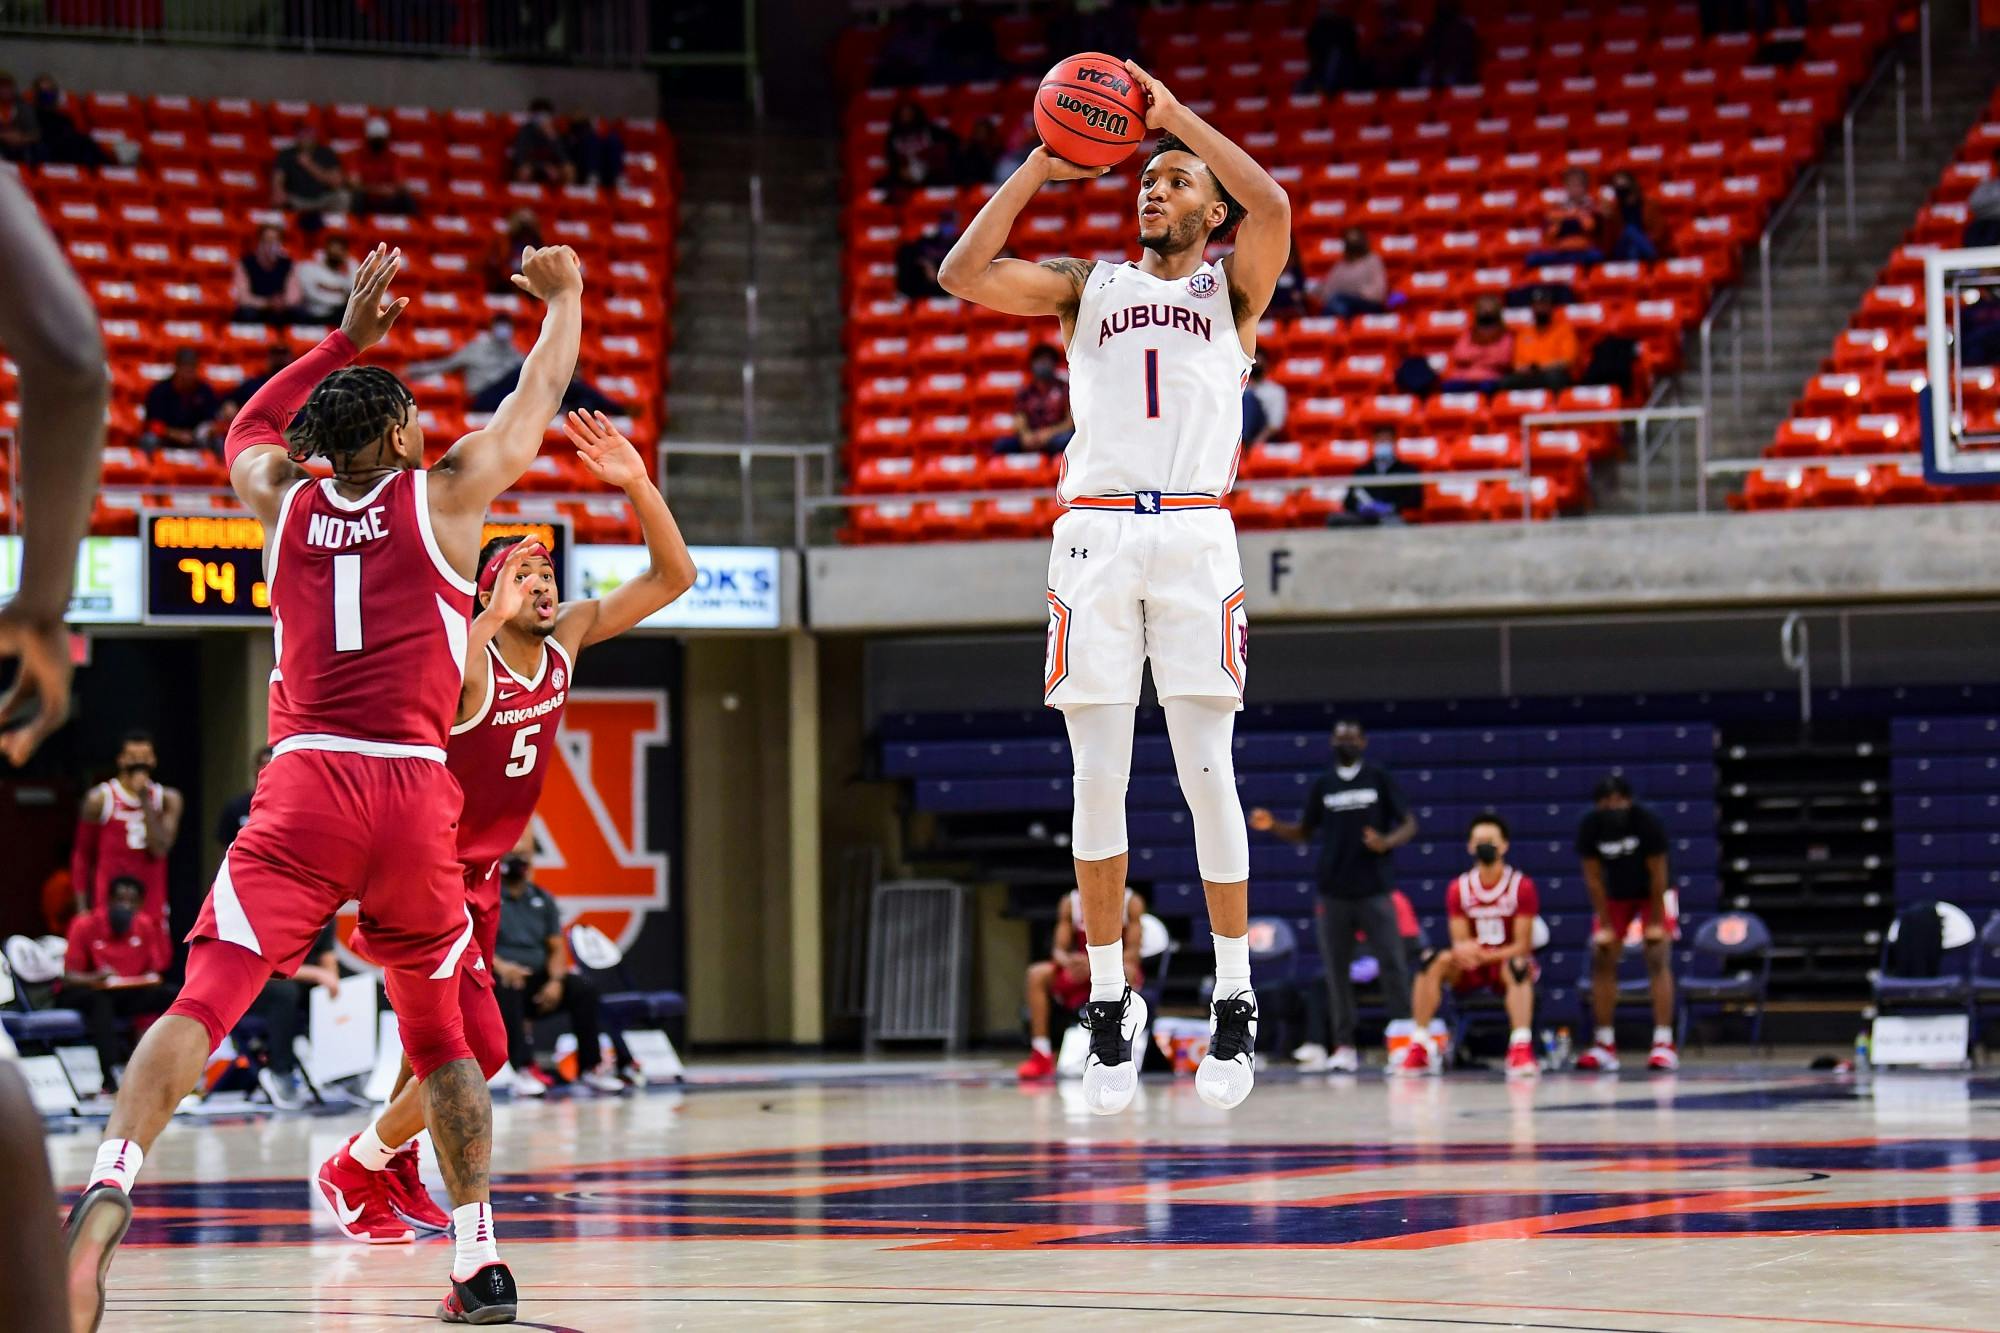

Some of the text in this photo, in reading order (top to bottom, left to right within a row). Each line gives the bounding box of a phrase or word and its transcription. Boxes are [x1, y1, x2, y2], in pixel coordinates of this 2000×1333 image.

[1077, 67, 1131, 97] NCAA
[1056, 92, 1128, 137] Wilson
[1191, 274, 1213, 292] SEC
[1098, 303, 1212, 348] AUBURN
[1144, 348, 1160, 419] 1
[178, 558, 235, 604] 74
[1271, 549, 1292, 594] F
[333, 553, 363, 652] 1
[491, 691, 565, 726] ARKANSAS
[505, 723, 541, 778] 5
